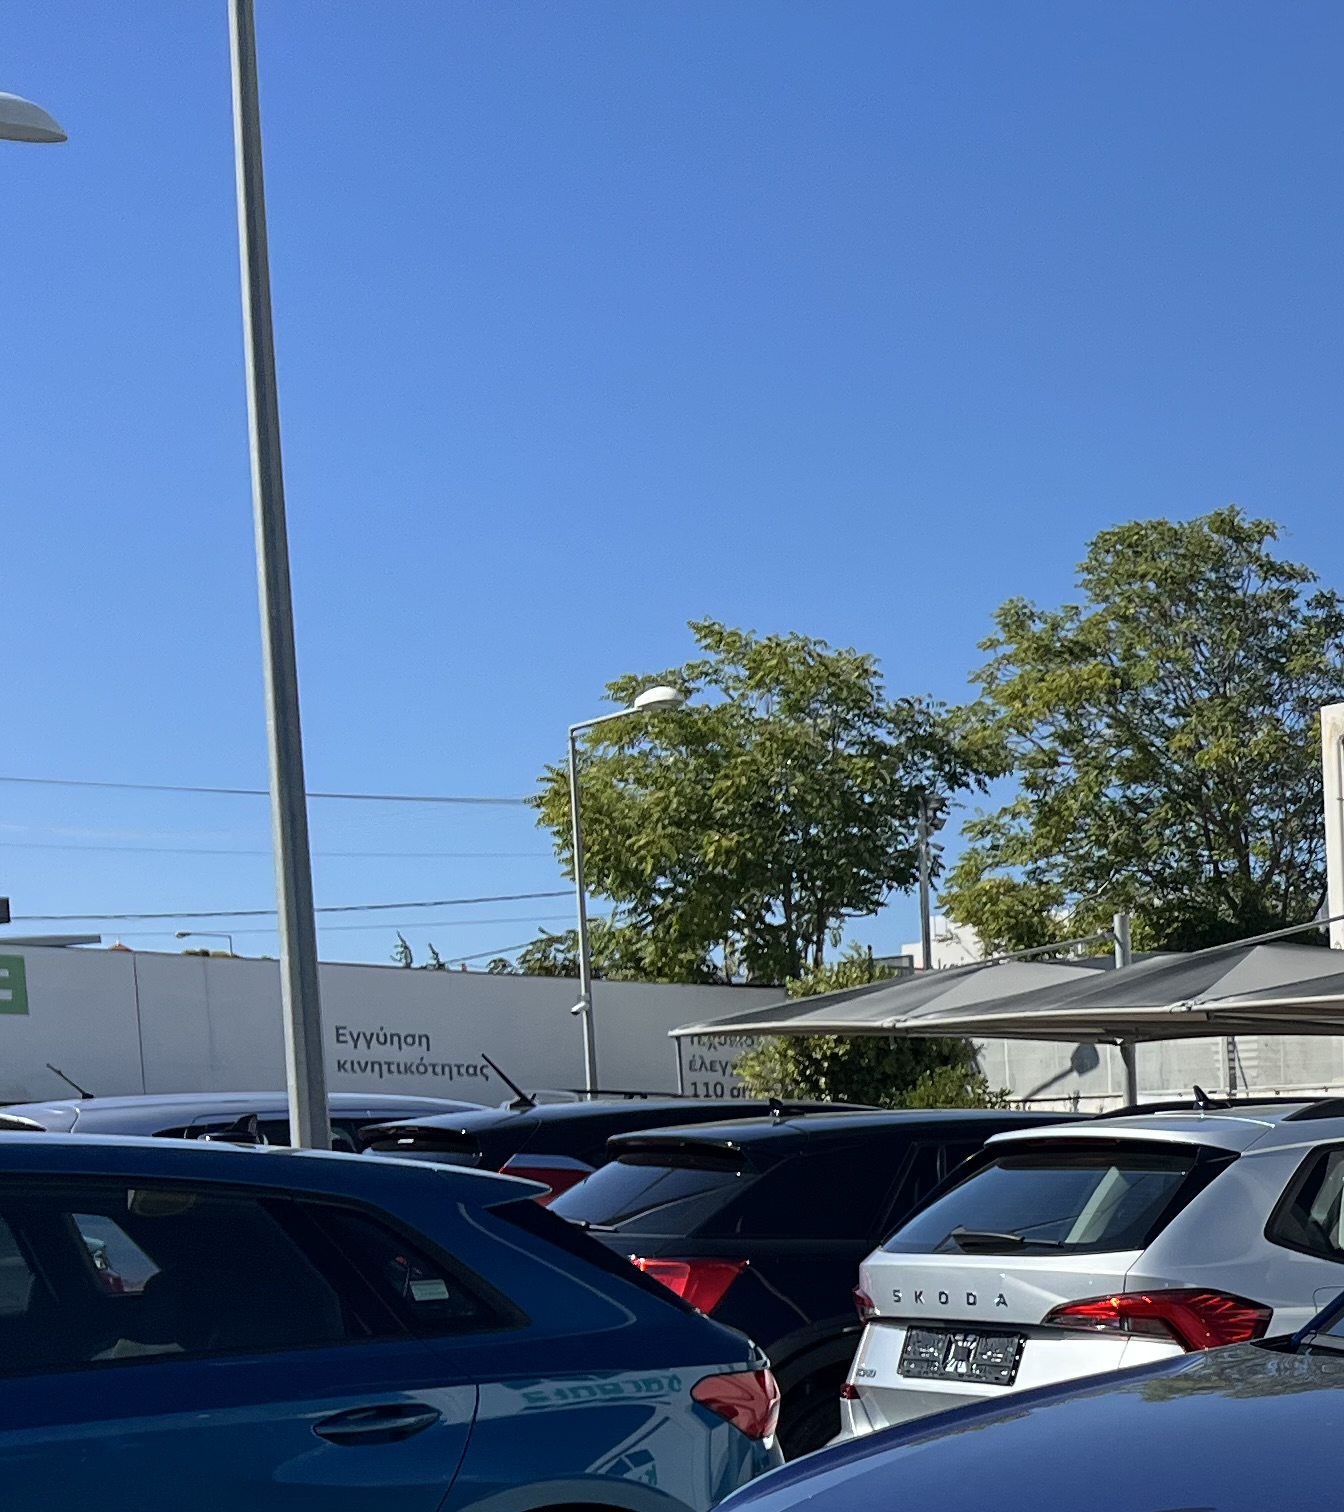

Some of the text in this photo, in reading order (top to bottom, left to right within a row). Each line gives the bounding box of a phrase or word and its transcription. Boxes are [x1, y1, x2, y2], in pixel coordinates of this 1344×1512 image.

[335, 1024, 431, 1052] Εγγύηση
[336, 1056, 489, 1082] κινητικότητας
[691, 1081, 725, 1099] 110
[892, 1289, 1008, 1308] SKODA
